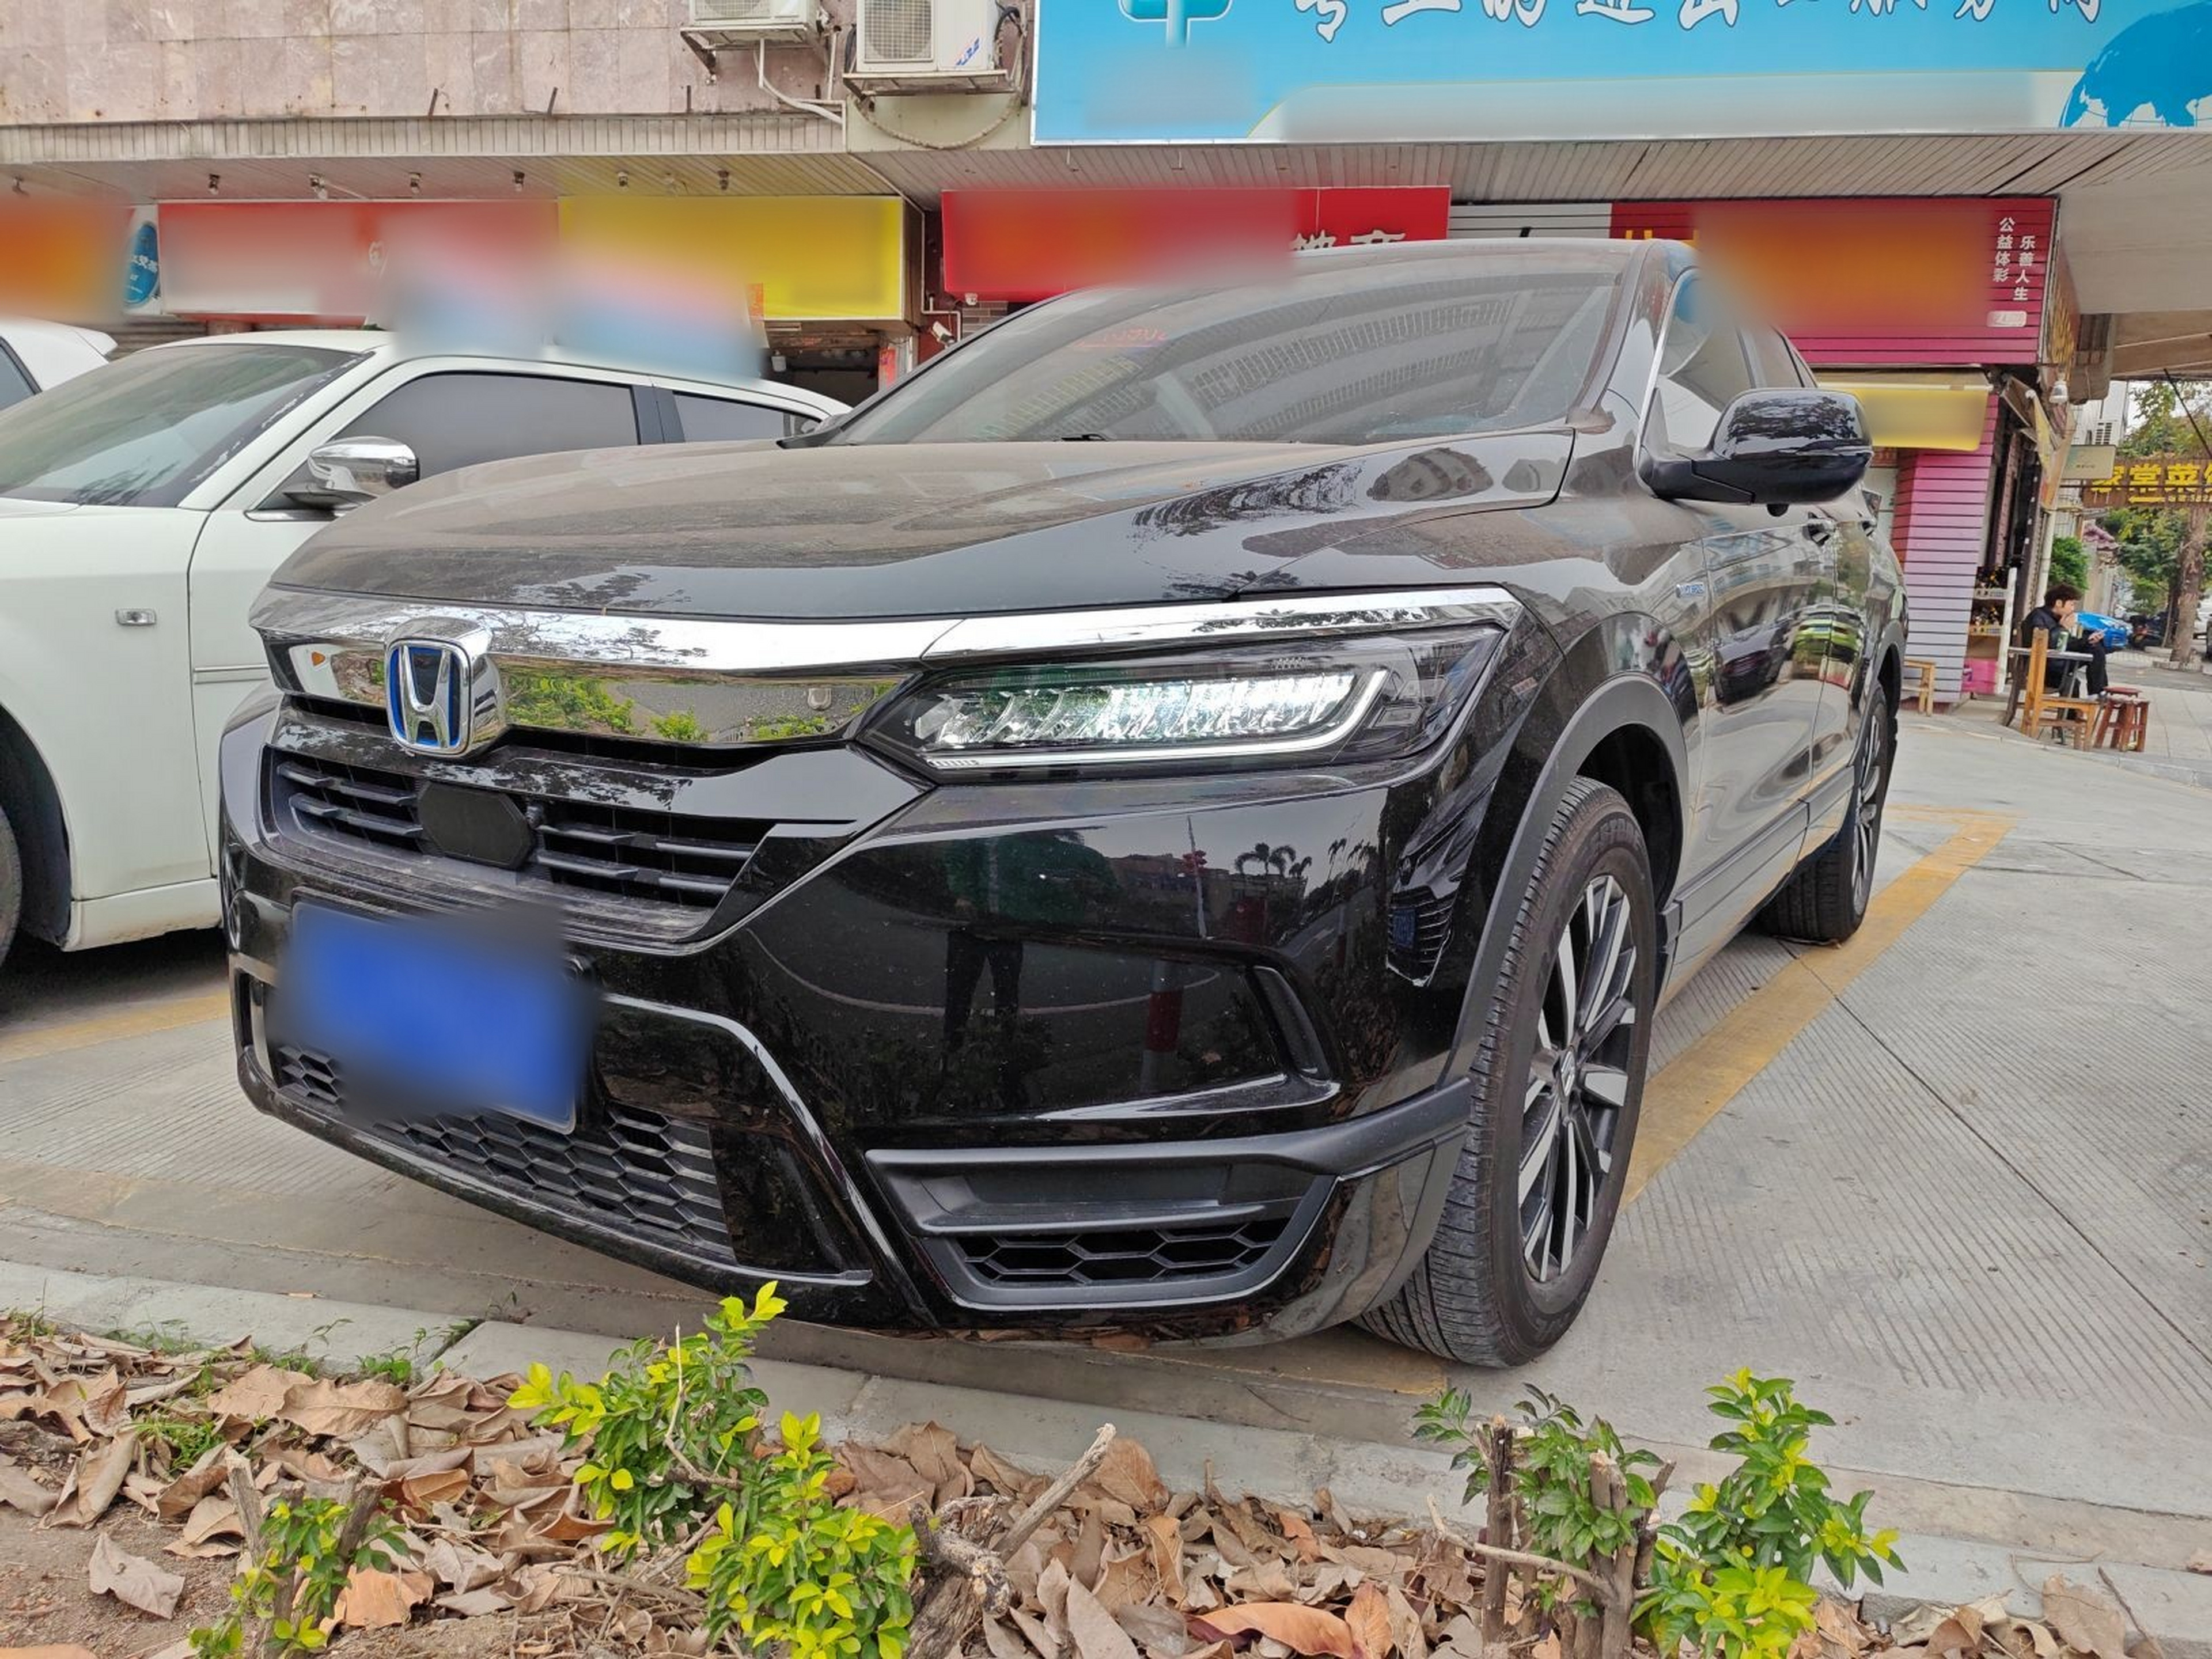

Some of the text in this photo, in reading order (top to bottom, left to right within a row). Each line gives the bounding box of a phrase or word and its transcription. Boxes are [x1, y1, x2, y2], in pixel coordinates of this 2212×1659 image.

[1993, 217, 2016, 282] 公益体彩
[2013, 235, 2036, 301] 乐善人生
